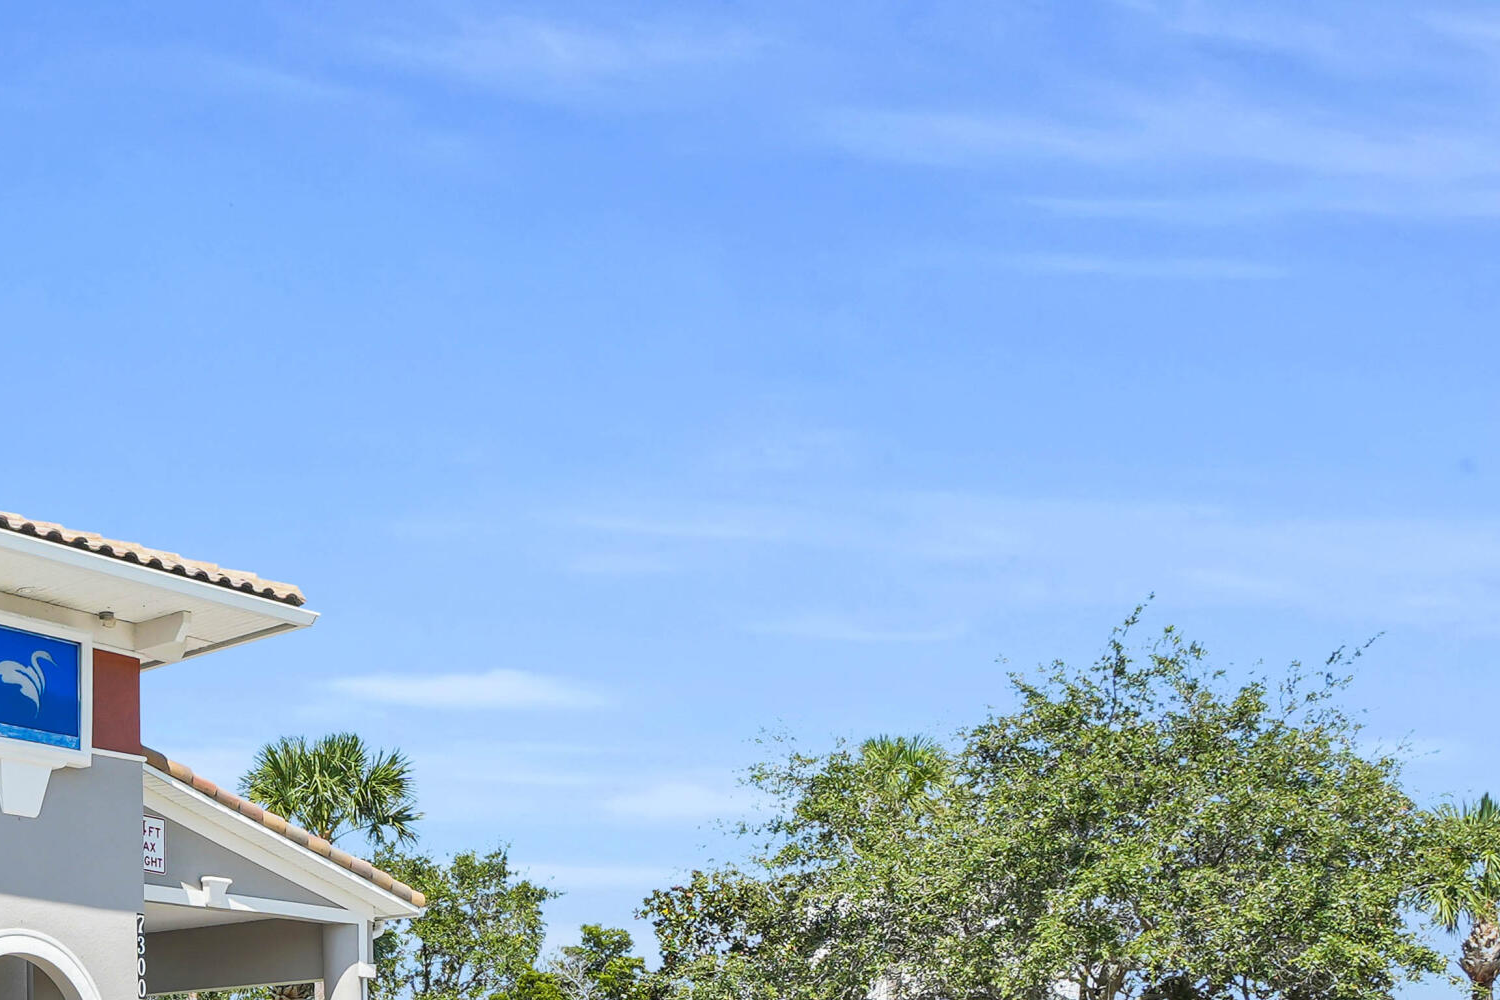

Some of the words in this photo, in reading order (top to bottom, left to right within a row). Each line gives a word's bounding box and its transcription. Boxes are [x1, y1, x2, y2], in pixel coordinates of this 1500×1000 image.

[143, 841, 156, 853] AX
[144, 856, 163, 868] GHT
[137, 915, 147, 998] 7300
